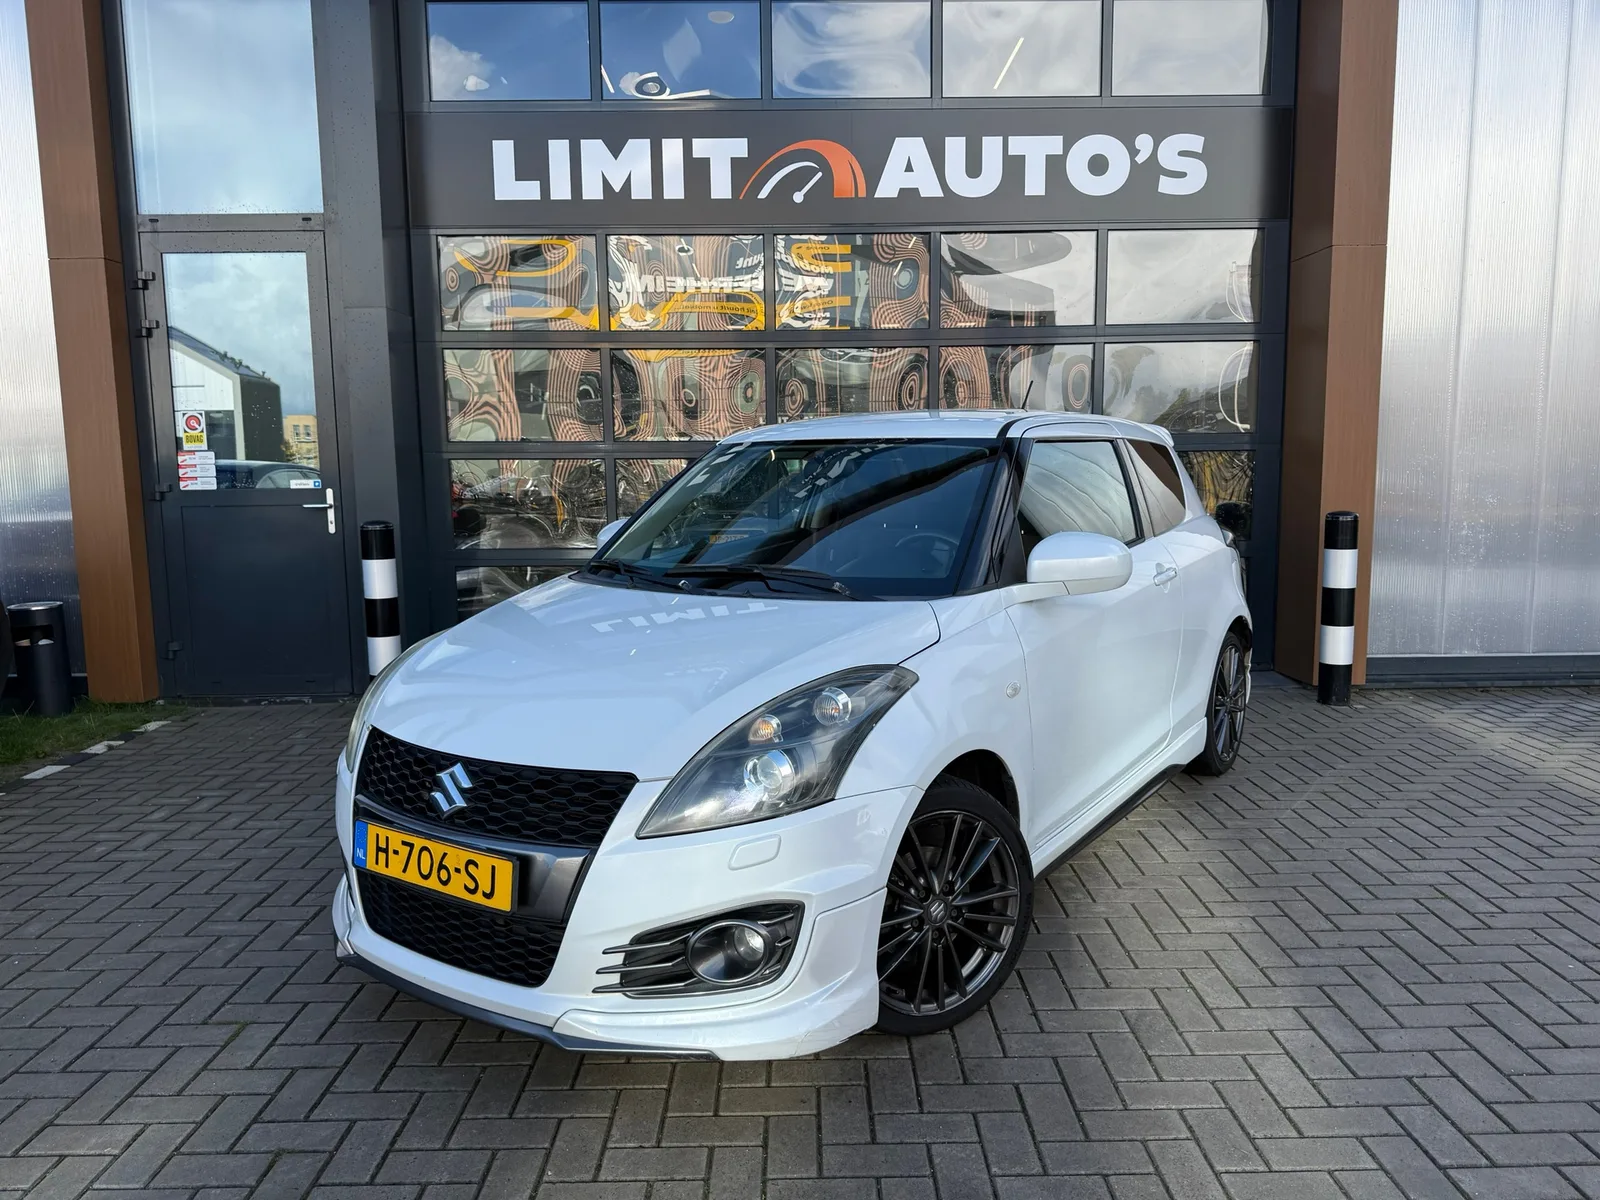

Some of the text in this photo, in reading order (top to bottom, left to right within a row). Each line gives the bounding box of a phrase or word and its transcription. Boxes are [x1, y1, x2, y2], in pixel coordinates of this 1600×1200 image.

[491, 132, 1209, 201] LIMIT AUTO'S
[185, 435, 204, 444] BOVAG
[356, 847, 366, 860] NL
[375, 832, 497, 900] H-706-SJ
